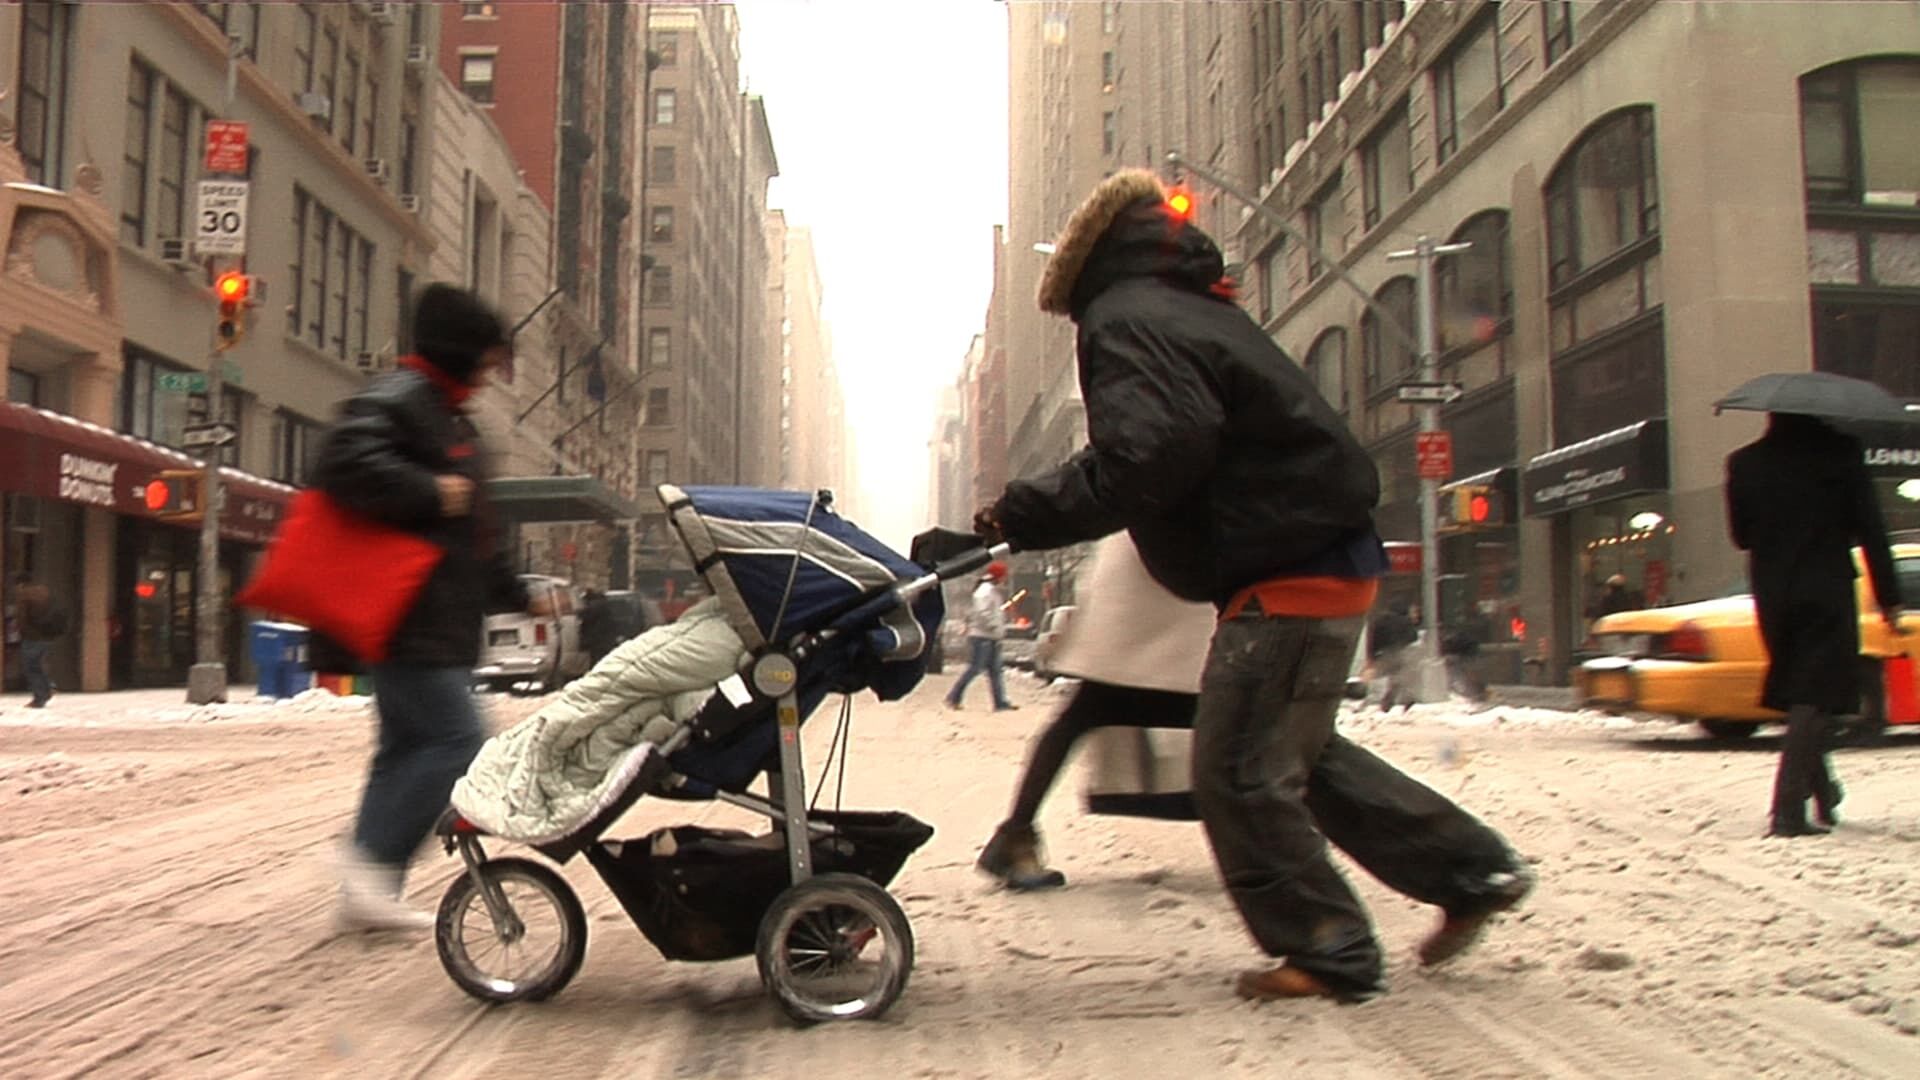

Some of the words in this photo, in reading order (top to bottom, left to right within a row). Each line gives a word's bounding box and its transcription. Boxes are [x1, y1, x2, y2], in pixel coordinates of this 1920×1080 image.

[203, 185, 245, 196] SPEED
[205, 199, 239, 208] LIMIT
[201, 210, 241, 234] 30
[60, 476, 116, 506] DONUTS
